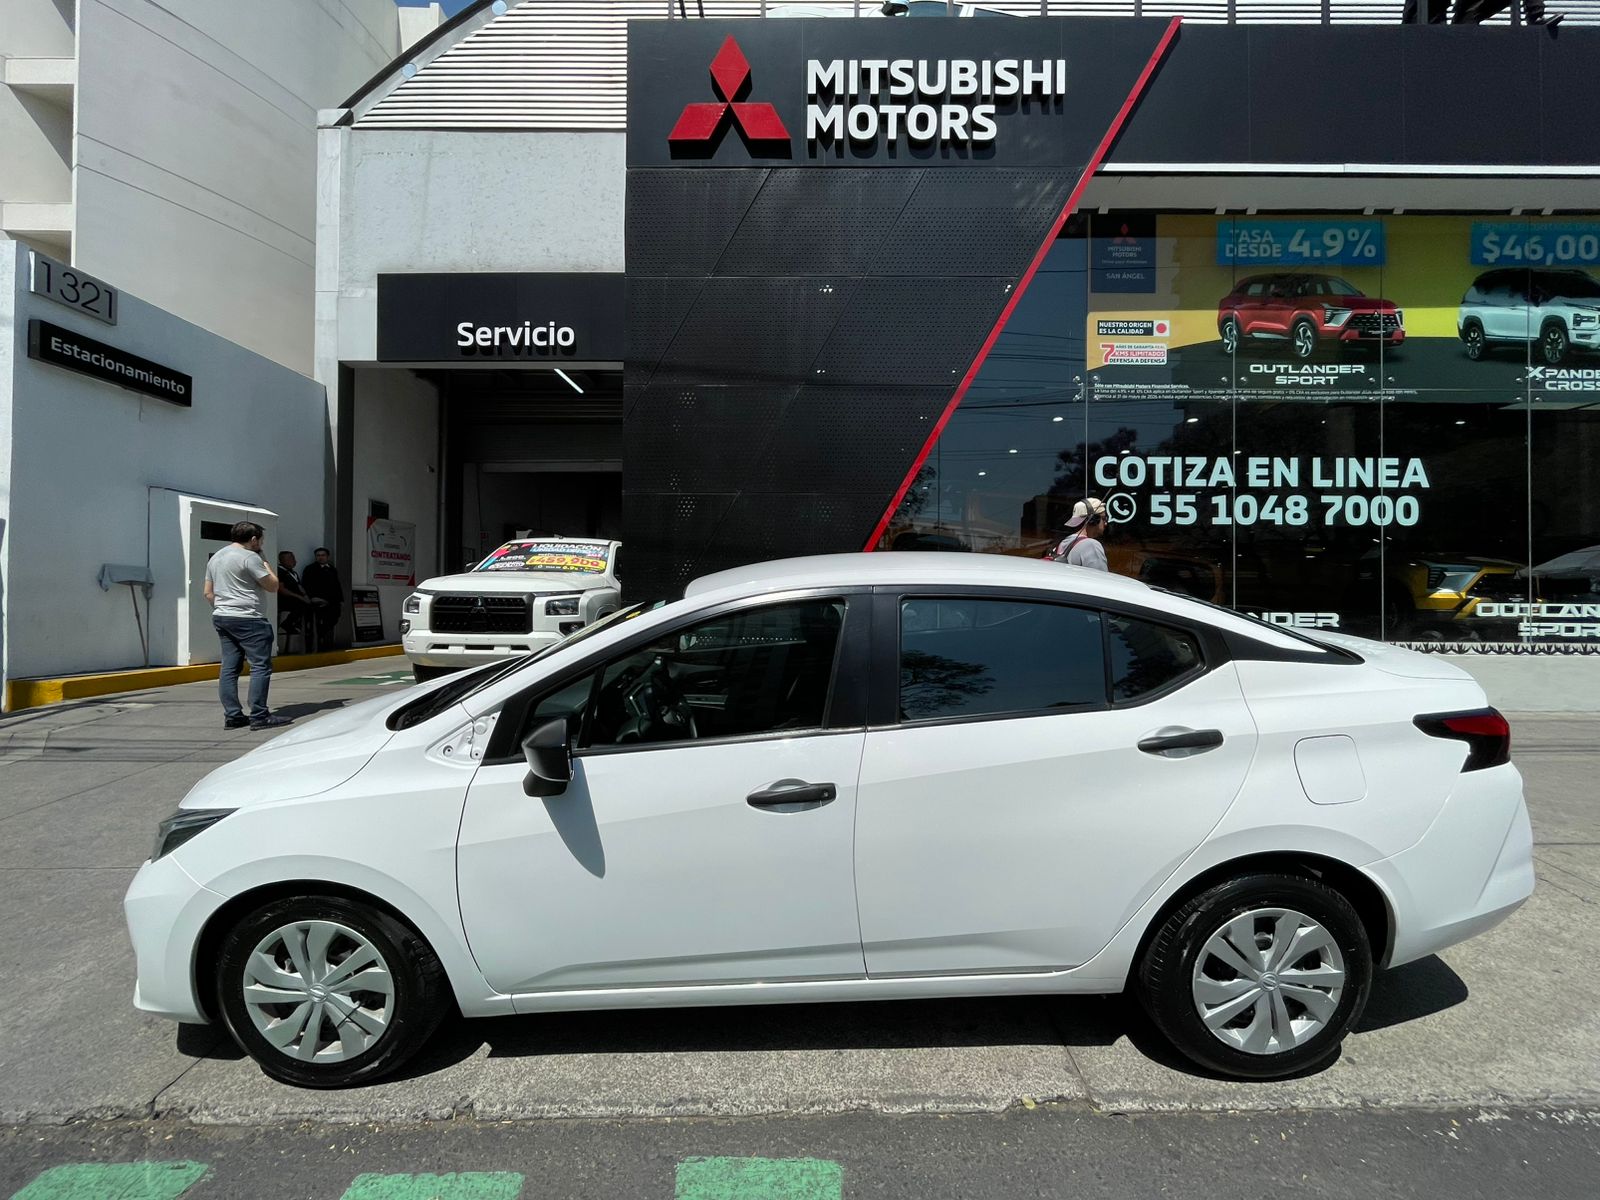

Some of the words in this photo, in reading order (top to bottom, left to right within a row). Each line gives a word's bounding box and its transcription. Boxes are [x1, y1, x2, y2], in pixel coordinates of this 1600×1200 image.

[806, 59, 1066, 96] MITSUBISHI
[806, 104, 998, 141] MOTORS
[1225, 243, 1282, 257] DESDE
[1229, 229, 1274, 243] TASA
[1288, 228, 1377, 258] 4.9%
[1482, 231, 1598, 265] $46,00
[41, 260, 113, 319] 1321
[457, 321, 575, 346] Servicio
[50, 336, 185, 395] Estacionamiento
[1102, 344, 1115, 363] 7
[1249, 364, 1365, 374] OUTLANDER
[1275, 376, 1339, 385] SPORT
[1094, 456, 1237, 488] COTIZA
[1247, 457, 1299, 488] EN
[1312, 457, 1430, 488] LINEA
[1150, 494, 1197, 525] 55
[1211, 494, 1309, 526] 1048
[1320, 494, 1420, 526] 7000
